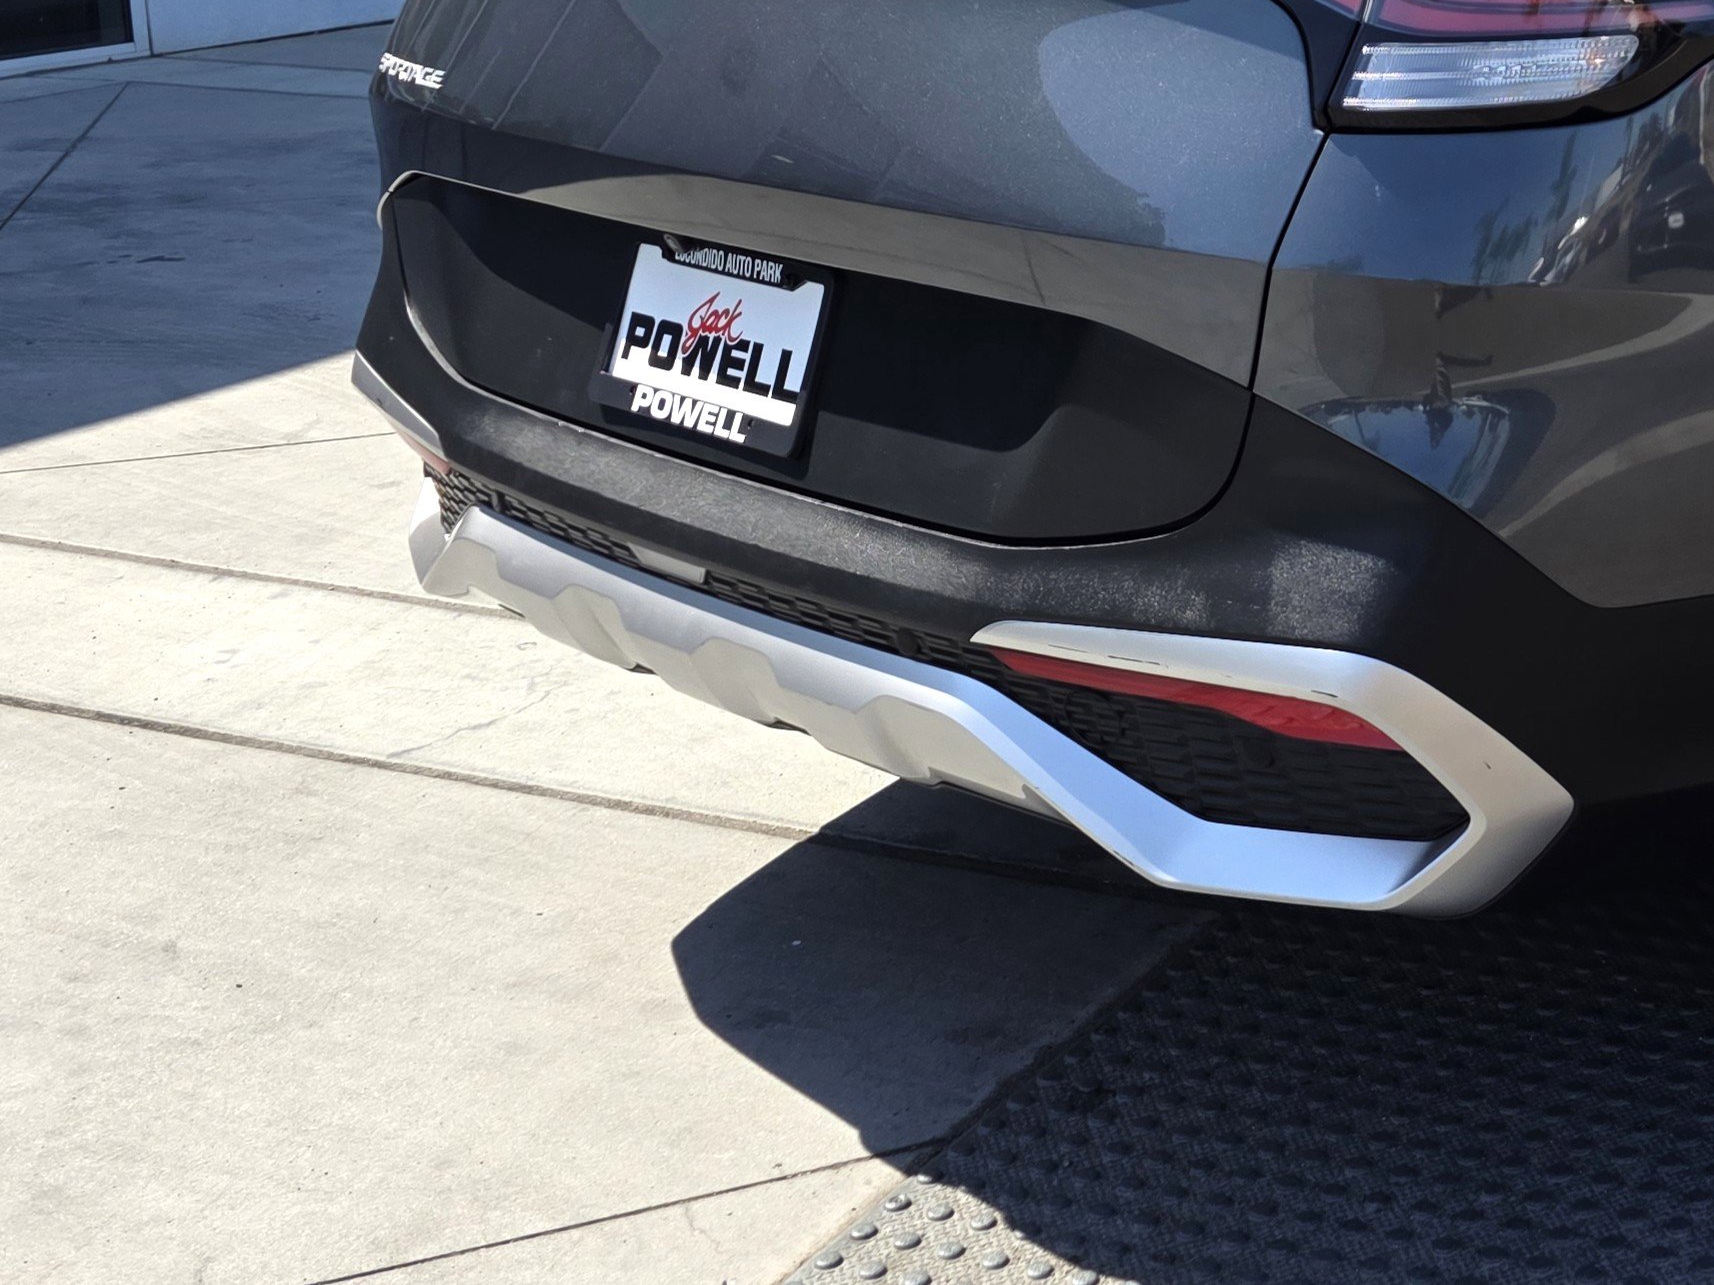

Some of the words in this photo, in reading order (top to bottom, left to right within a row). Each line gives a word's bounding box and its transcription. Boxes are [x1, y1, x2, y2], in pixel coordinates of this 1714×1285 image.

[725, 253, 752, 278] AUTO
[753, 259, 783, 284] PARK
[681, 291, 743, 355] Jack
[621, 311, 800, 404] POWELL
[630, 383, 748, 444] POWELL
